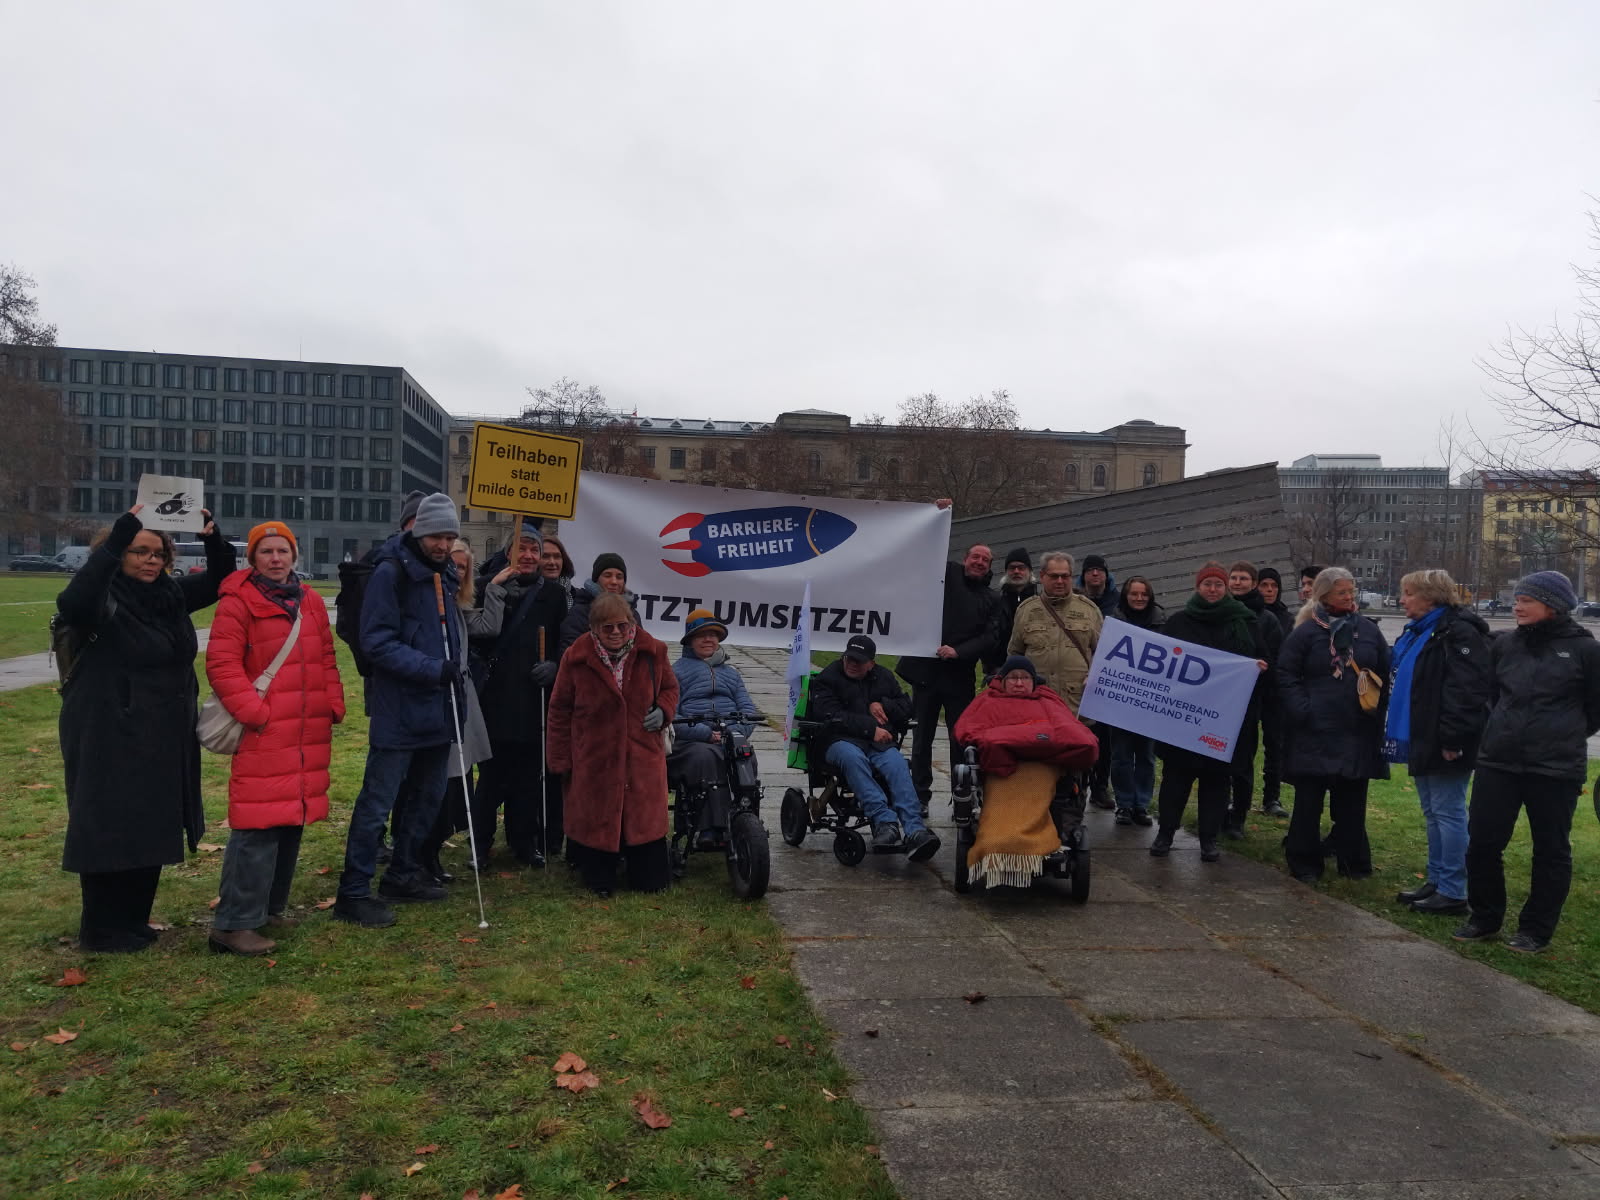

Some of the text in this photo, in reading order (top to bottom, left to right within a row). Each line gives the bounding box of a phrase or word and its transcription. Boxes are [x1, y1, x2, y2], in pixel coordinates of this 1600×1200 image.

[487, 441, 568, 468] Teilhaben
[511, 468, 540, 482] statt
[478, 482, 515, 497] milde
[707, 517, 799, 539] BARRIERE-
[717, 538, 794, 559] FREIHEIT
[634, 593, 703, 623] TZT
[1100, 666, 1171, 694] ALLGEMEINER
[1094, 687, 1202, 727] IN DEUTSCHLAND E.V.
[1097, 676, 1220, 719] BEHINDERTENVERBAND
